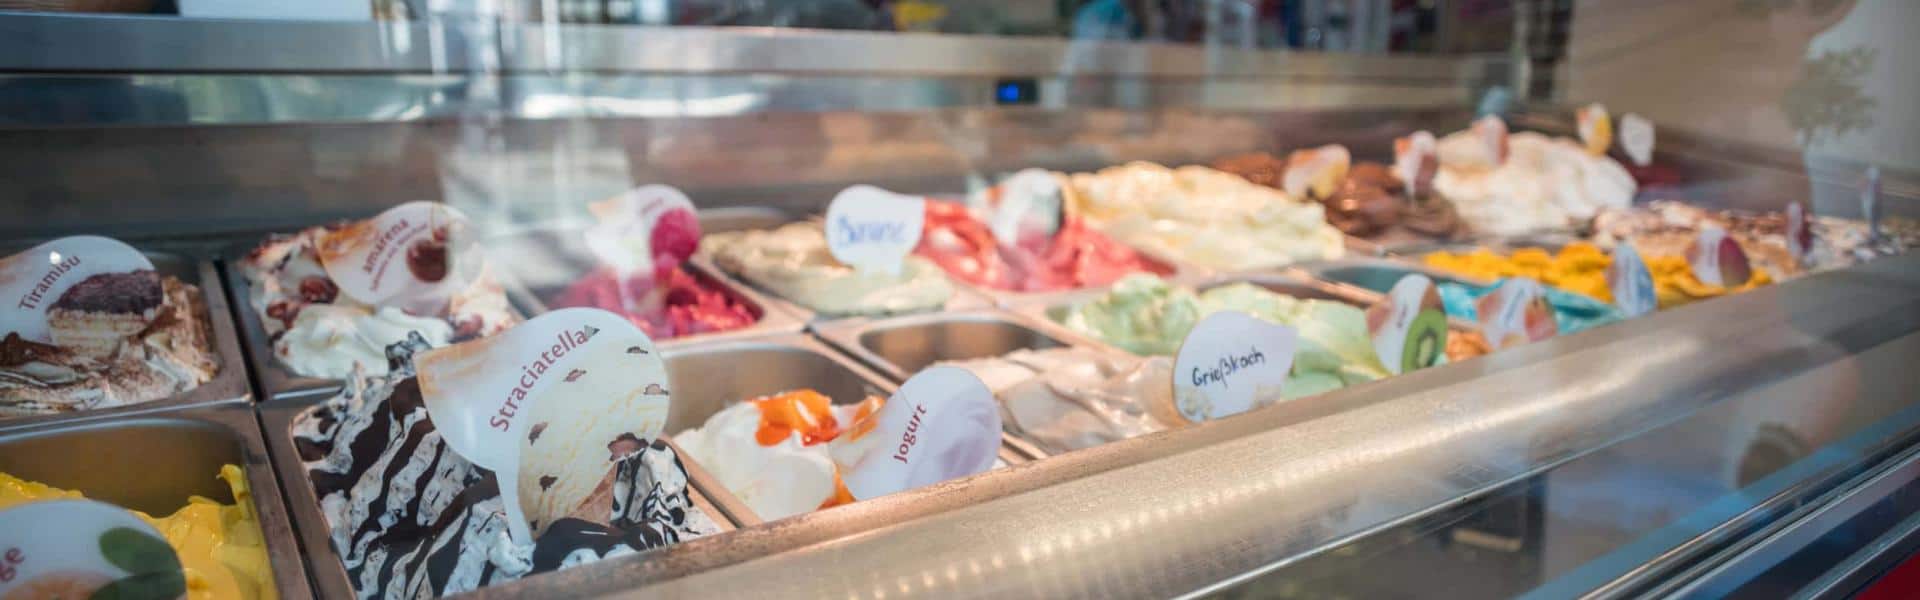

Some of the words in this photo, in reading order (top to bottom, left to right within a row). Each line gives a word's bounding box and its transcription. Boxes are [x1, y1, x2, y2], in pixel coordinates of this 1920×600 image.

[362, 219, 409, 273] amarena
[19, 255, 81, 309] Tiramisu
[489, 330, 589, 432] Straciatella
[893, 404, 926, 464] Jogurt
